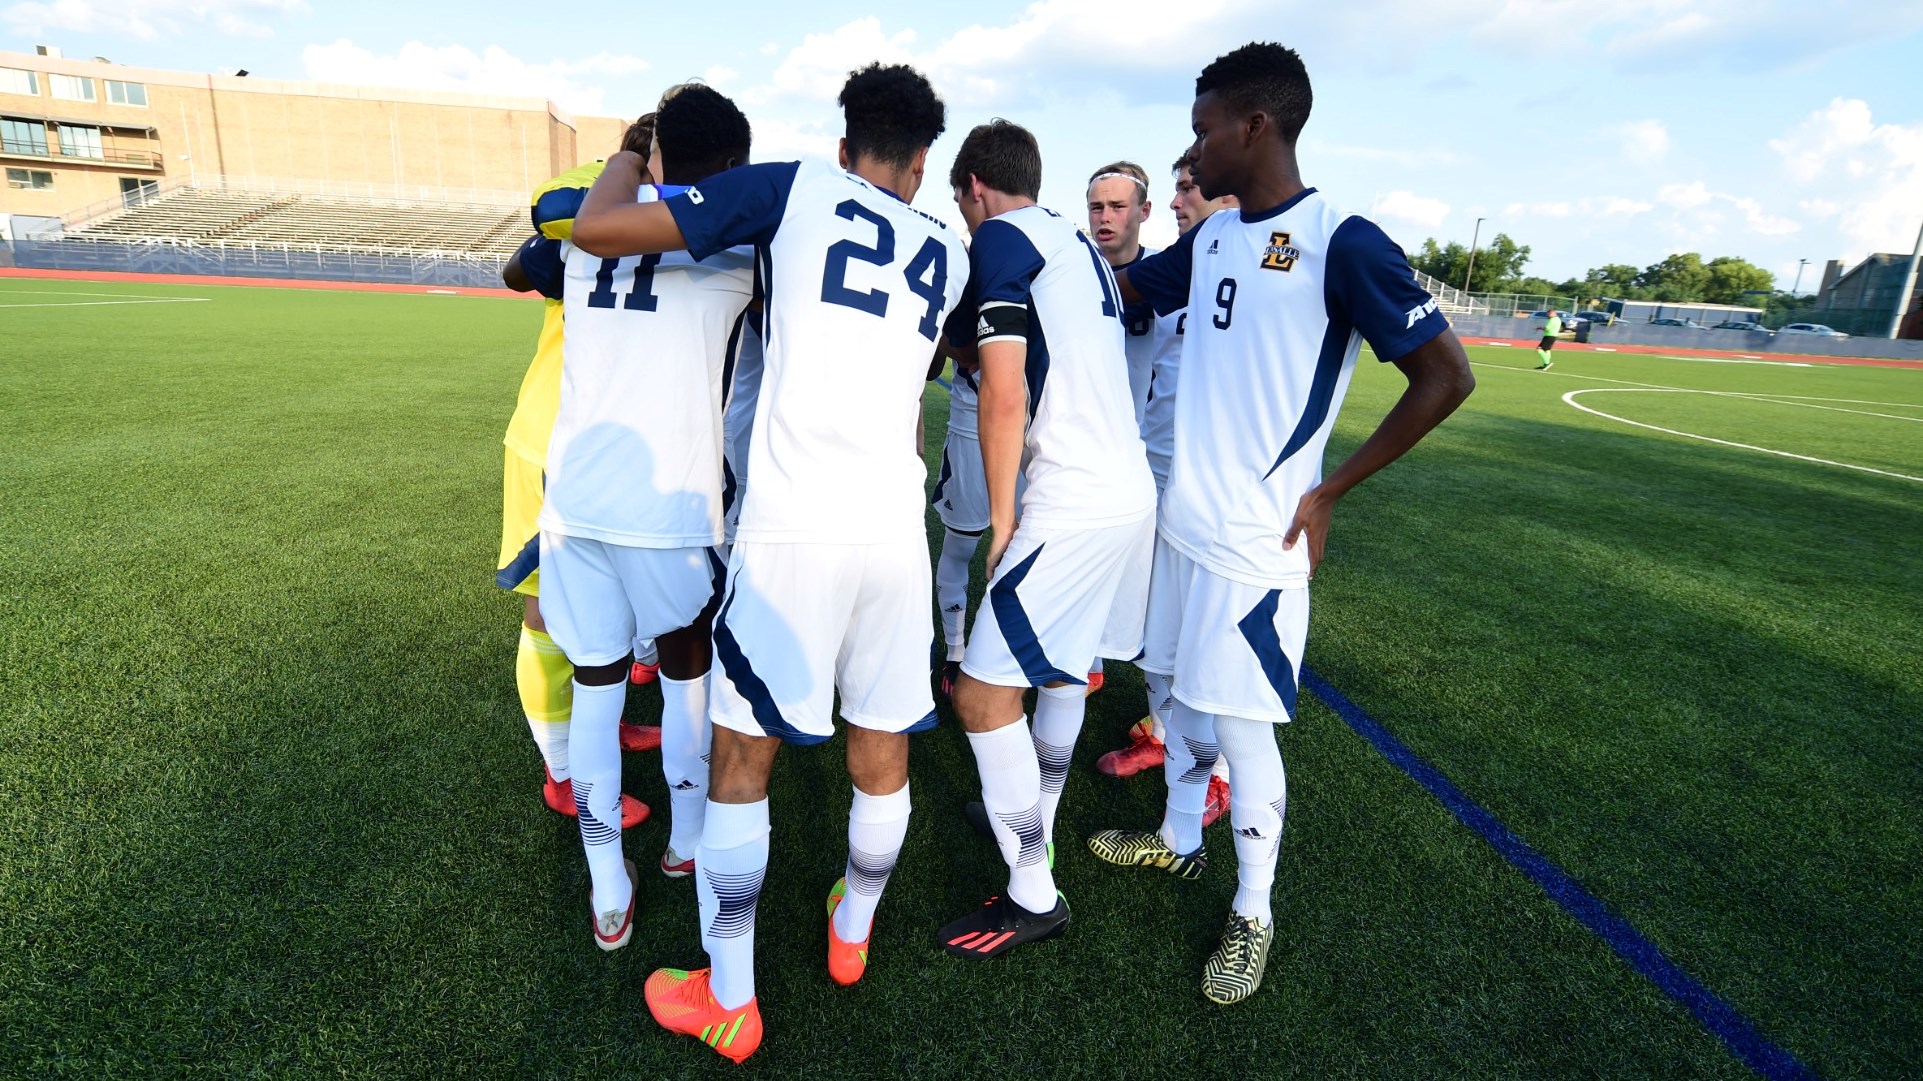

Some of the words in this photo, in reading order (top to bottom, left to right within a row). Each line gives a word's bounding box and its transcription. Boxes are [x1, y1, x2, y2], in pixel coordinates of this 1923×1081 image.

[821, 198, 947, 343] 24
[1075, 229, 1126, 328] 1
[1212, 277, 1237, 331] 9
